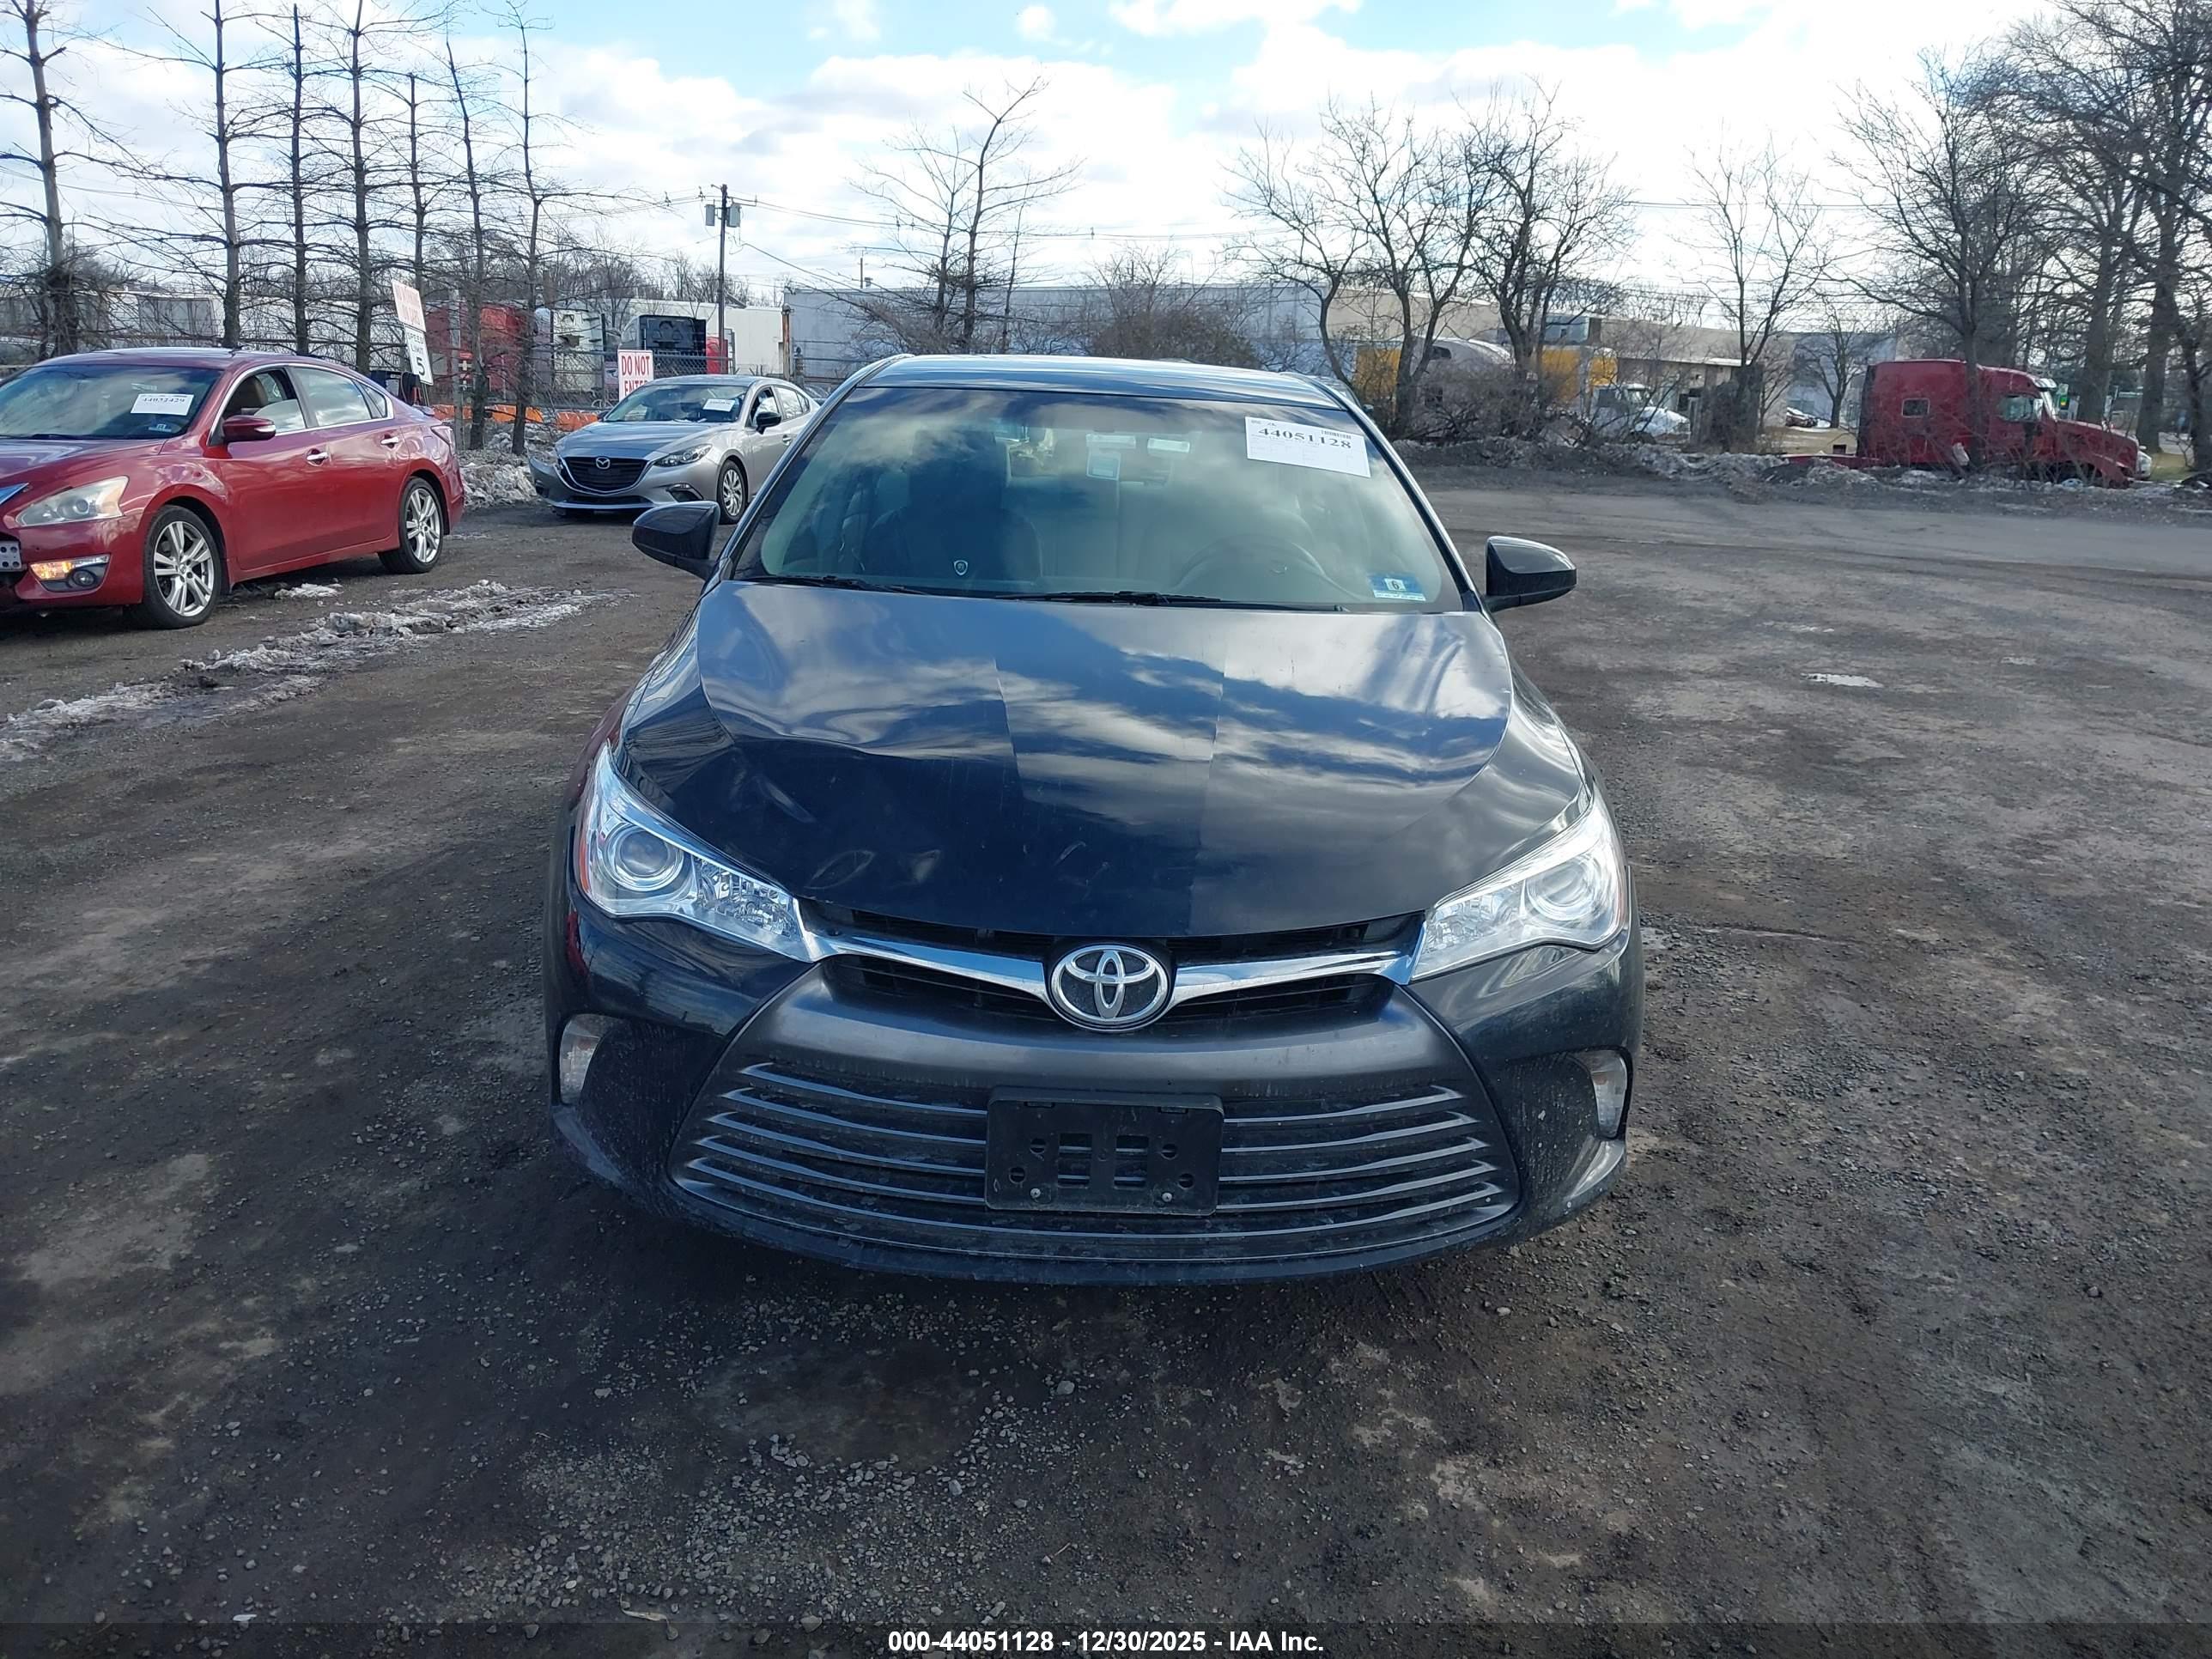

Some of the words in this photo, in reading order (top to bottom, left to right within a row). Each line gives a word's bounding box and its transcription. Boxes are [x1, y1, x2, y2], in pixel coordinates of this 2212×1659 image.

[407, 332, 424, 343] SPEED
[416, 356, 426, 376] 5
[621, 356, 633, 375] DO
[635, 356, 650, 375] NOT
[624, 380, 648, 397] ENT
[1258, 428, 1352, 449] 44051128
